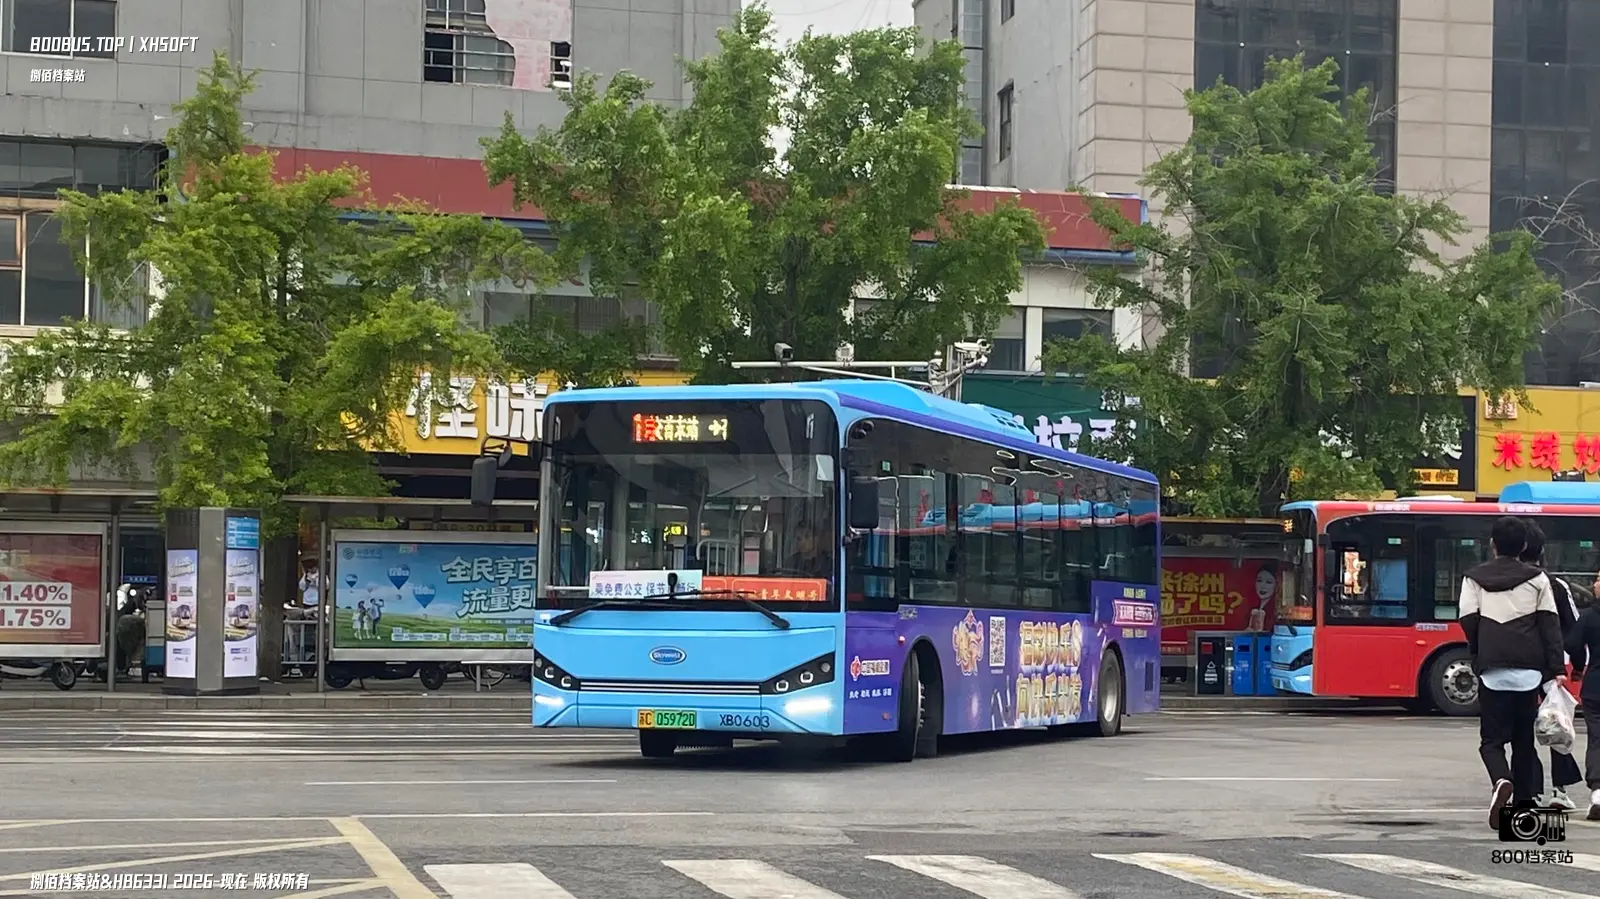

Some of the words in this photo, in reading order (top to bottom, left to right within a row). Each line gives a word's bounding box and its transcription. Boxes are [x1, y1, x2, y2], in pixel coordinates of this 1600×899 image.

[3, 584, 68, 601] 1.40%
[646, 583, 696, 596] 保节畅行
[455, 586, 534, 618] 流量更
[0, 609, 66, 627] 1.75%
[656, 712, 695, 726] 05972D
[720, 714, 770, 728] XB0603
